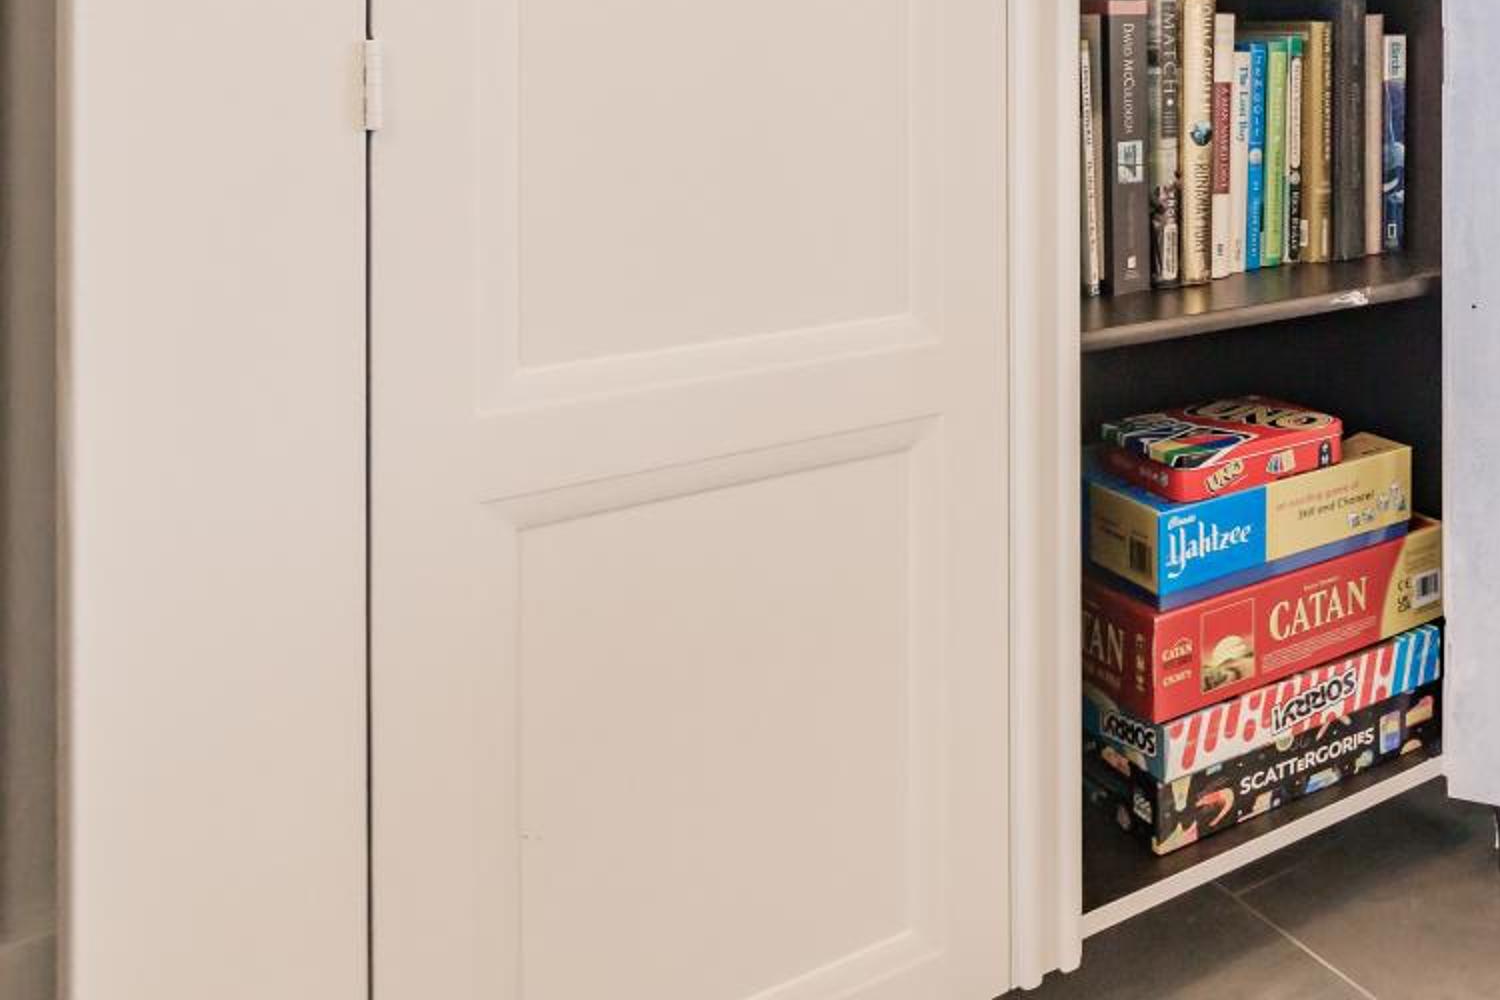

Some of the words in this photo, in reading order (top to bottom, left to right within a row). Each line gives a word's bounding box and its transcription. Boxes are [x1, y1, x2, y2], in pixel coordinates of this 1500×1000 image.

[1163, 15, 1176, 93] MATCH
[1165, 520, 1251, 579] Yahtzee
[1269, 576, 1370, 642] CATAN
[1240, 727, 1375, 795] SCATTERGORIES
